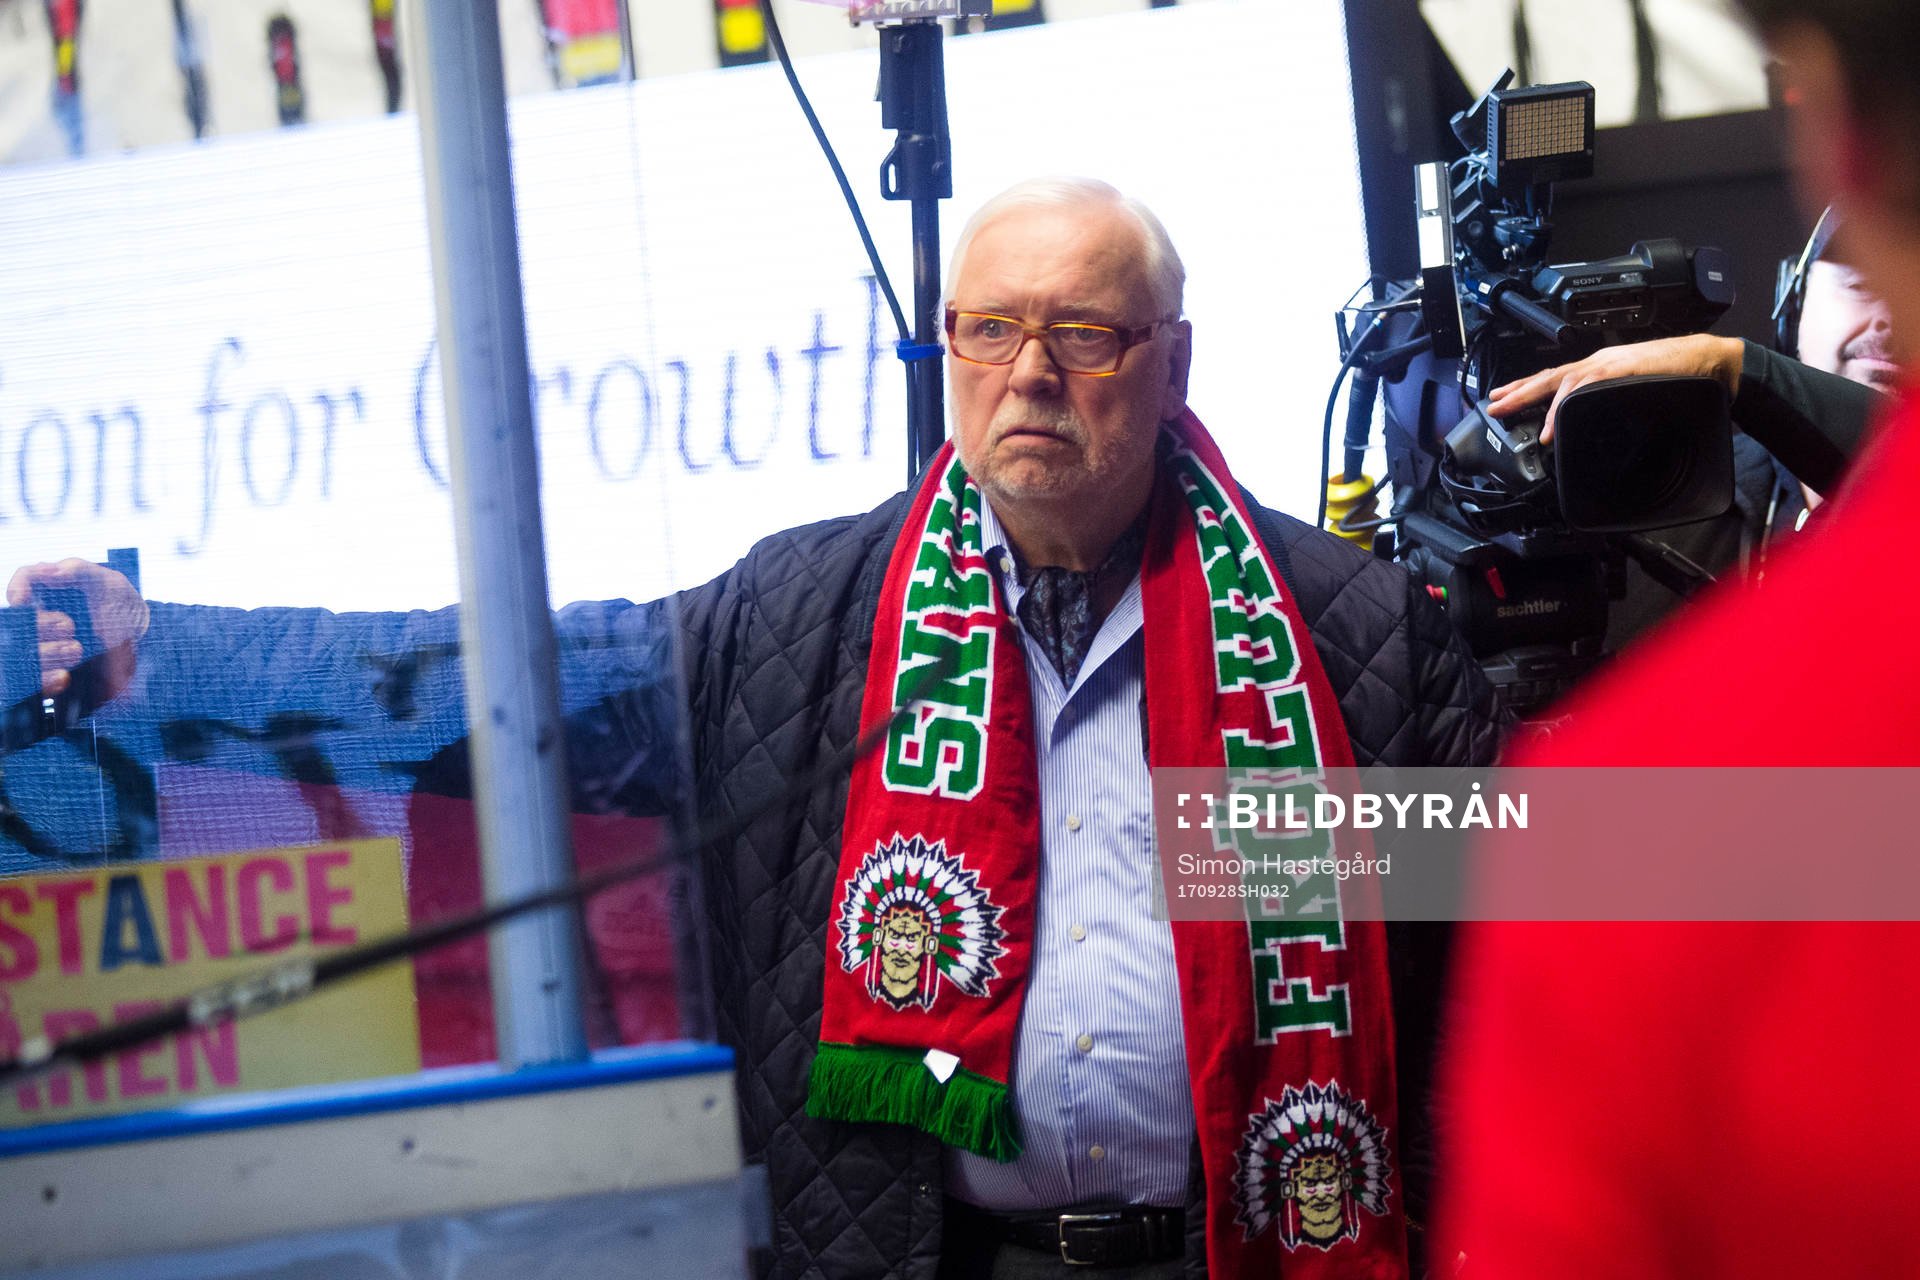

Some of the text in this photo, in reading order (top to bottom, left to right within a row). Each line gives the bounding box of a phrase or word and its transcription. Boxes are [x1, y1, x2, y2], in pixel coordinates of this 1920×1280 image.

[1572, 276, 1603, 287] SONY
[0, 405, 152, 523] on
[174, 337, 367, 555] for
[1497, 598, 1561, 618] sachtler
